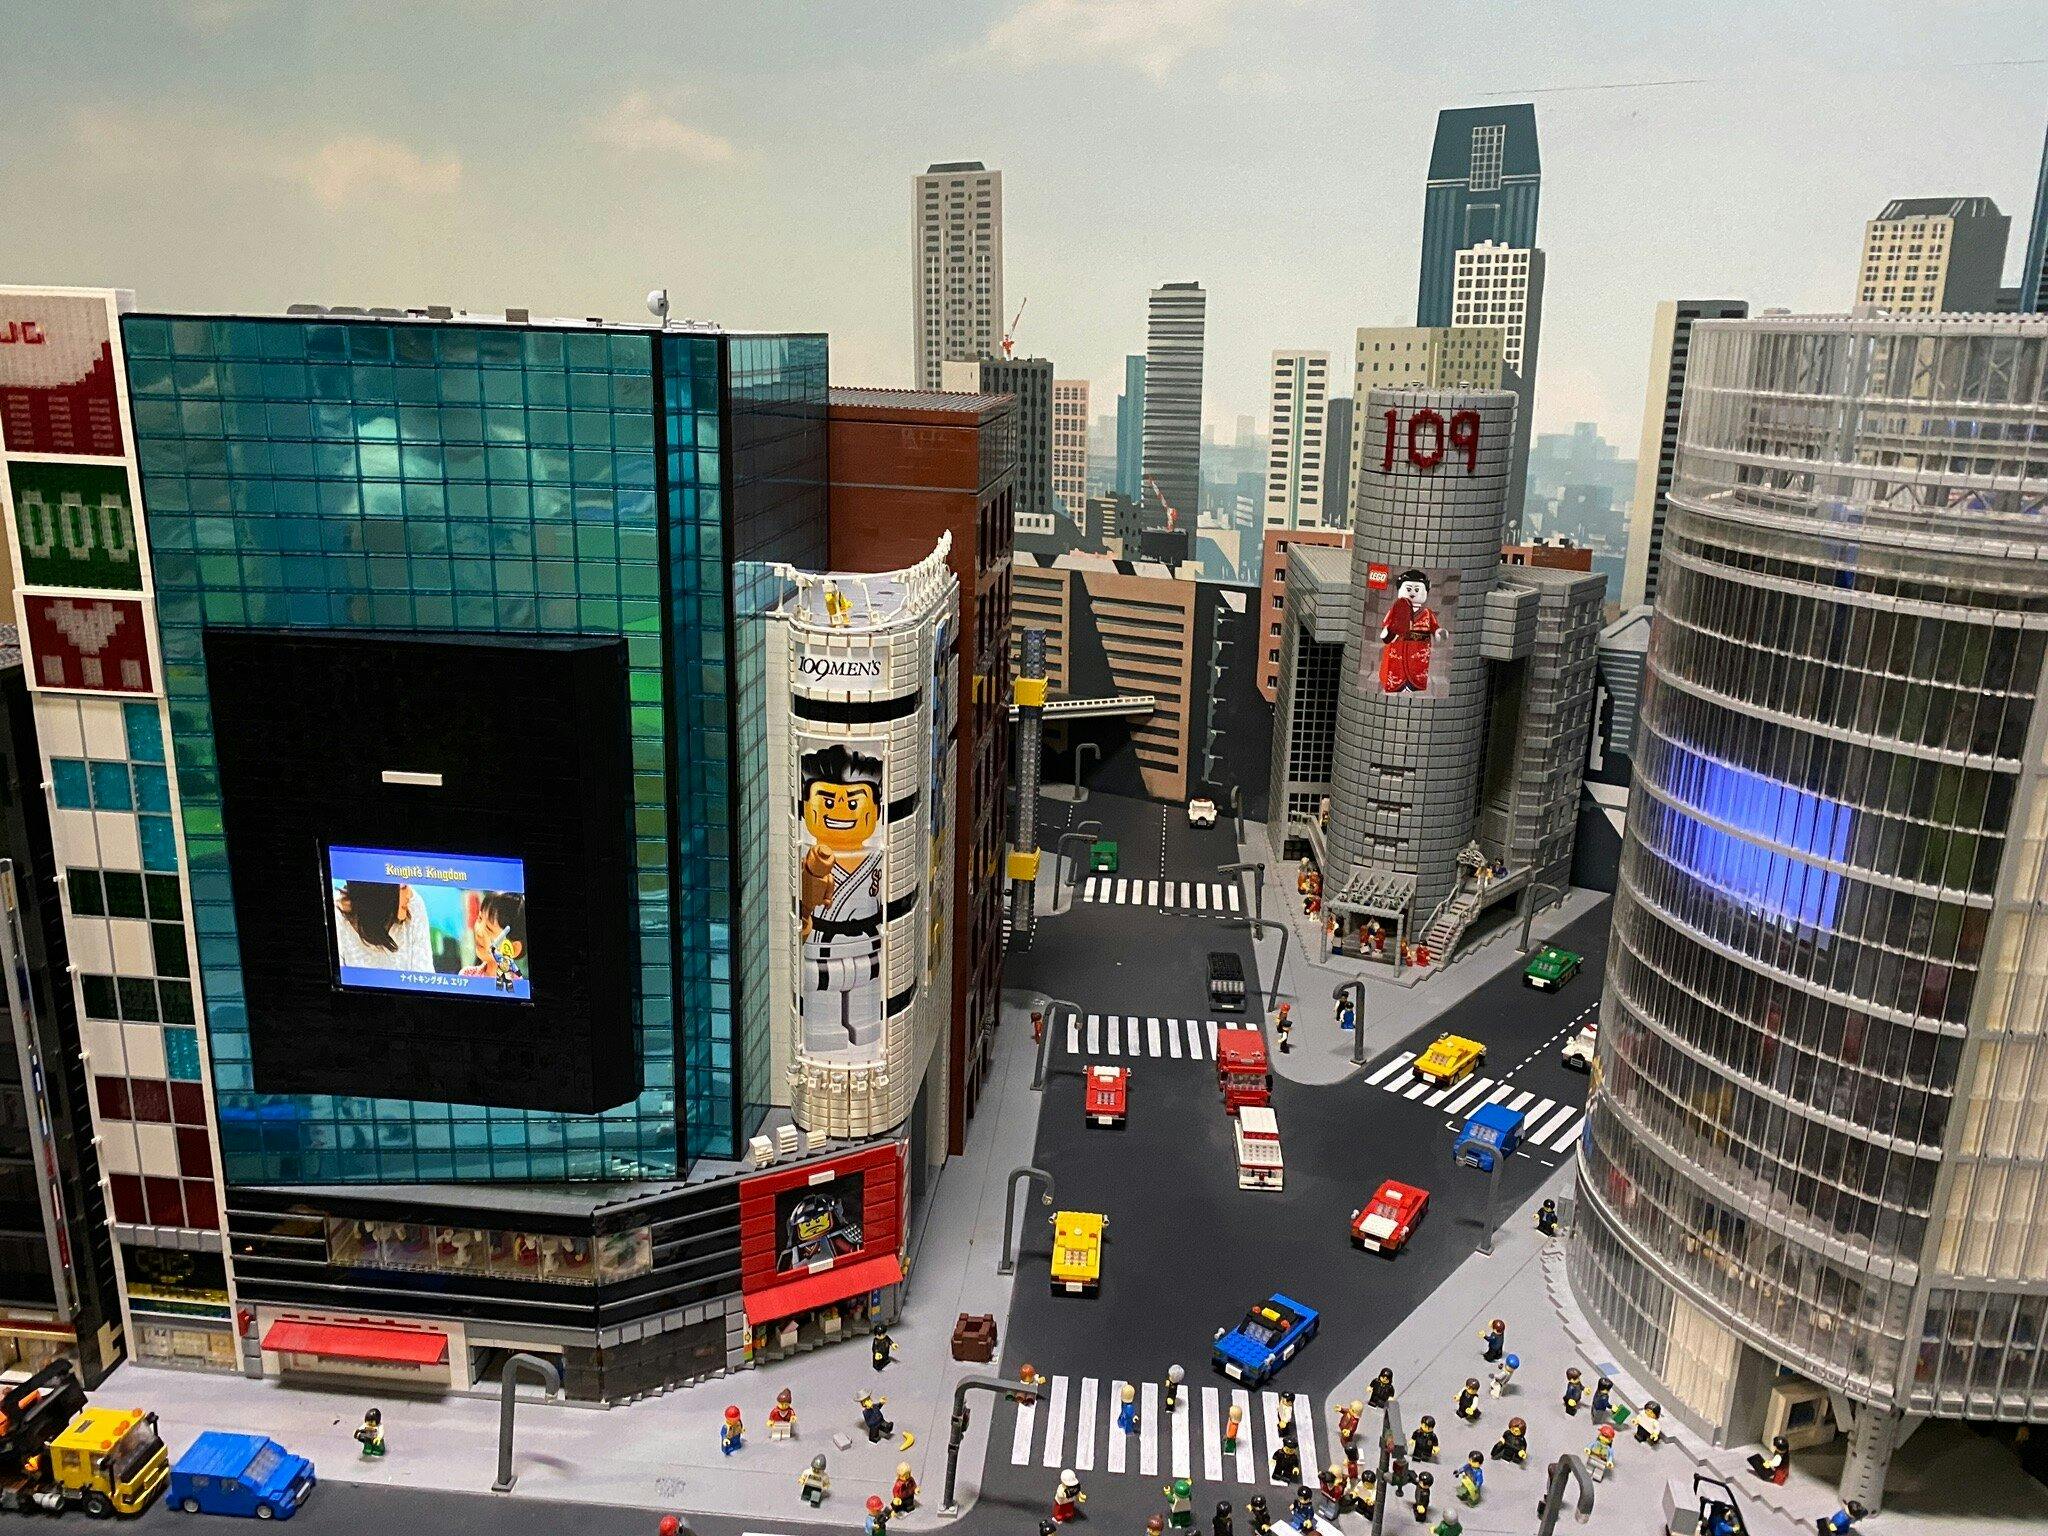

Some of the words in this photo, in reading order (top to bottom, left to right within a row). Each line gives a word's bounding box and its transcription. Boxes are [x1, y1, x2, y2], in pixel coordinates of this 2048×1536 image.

[1381, 406, 1480, 474] 109
[1369, 569, 1388, 583] LEGO
[384, 863, 423, 879] Knight's
[425, 866, 467, 882] Kingdom
[450, 977, 469, 987] エリア
